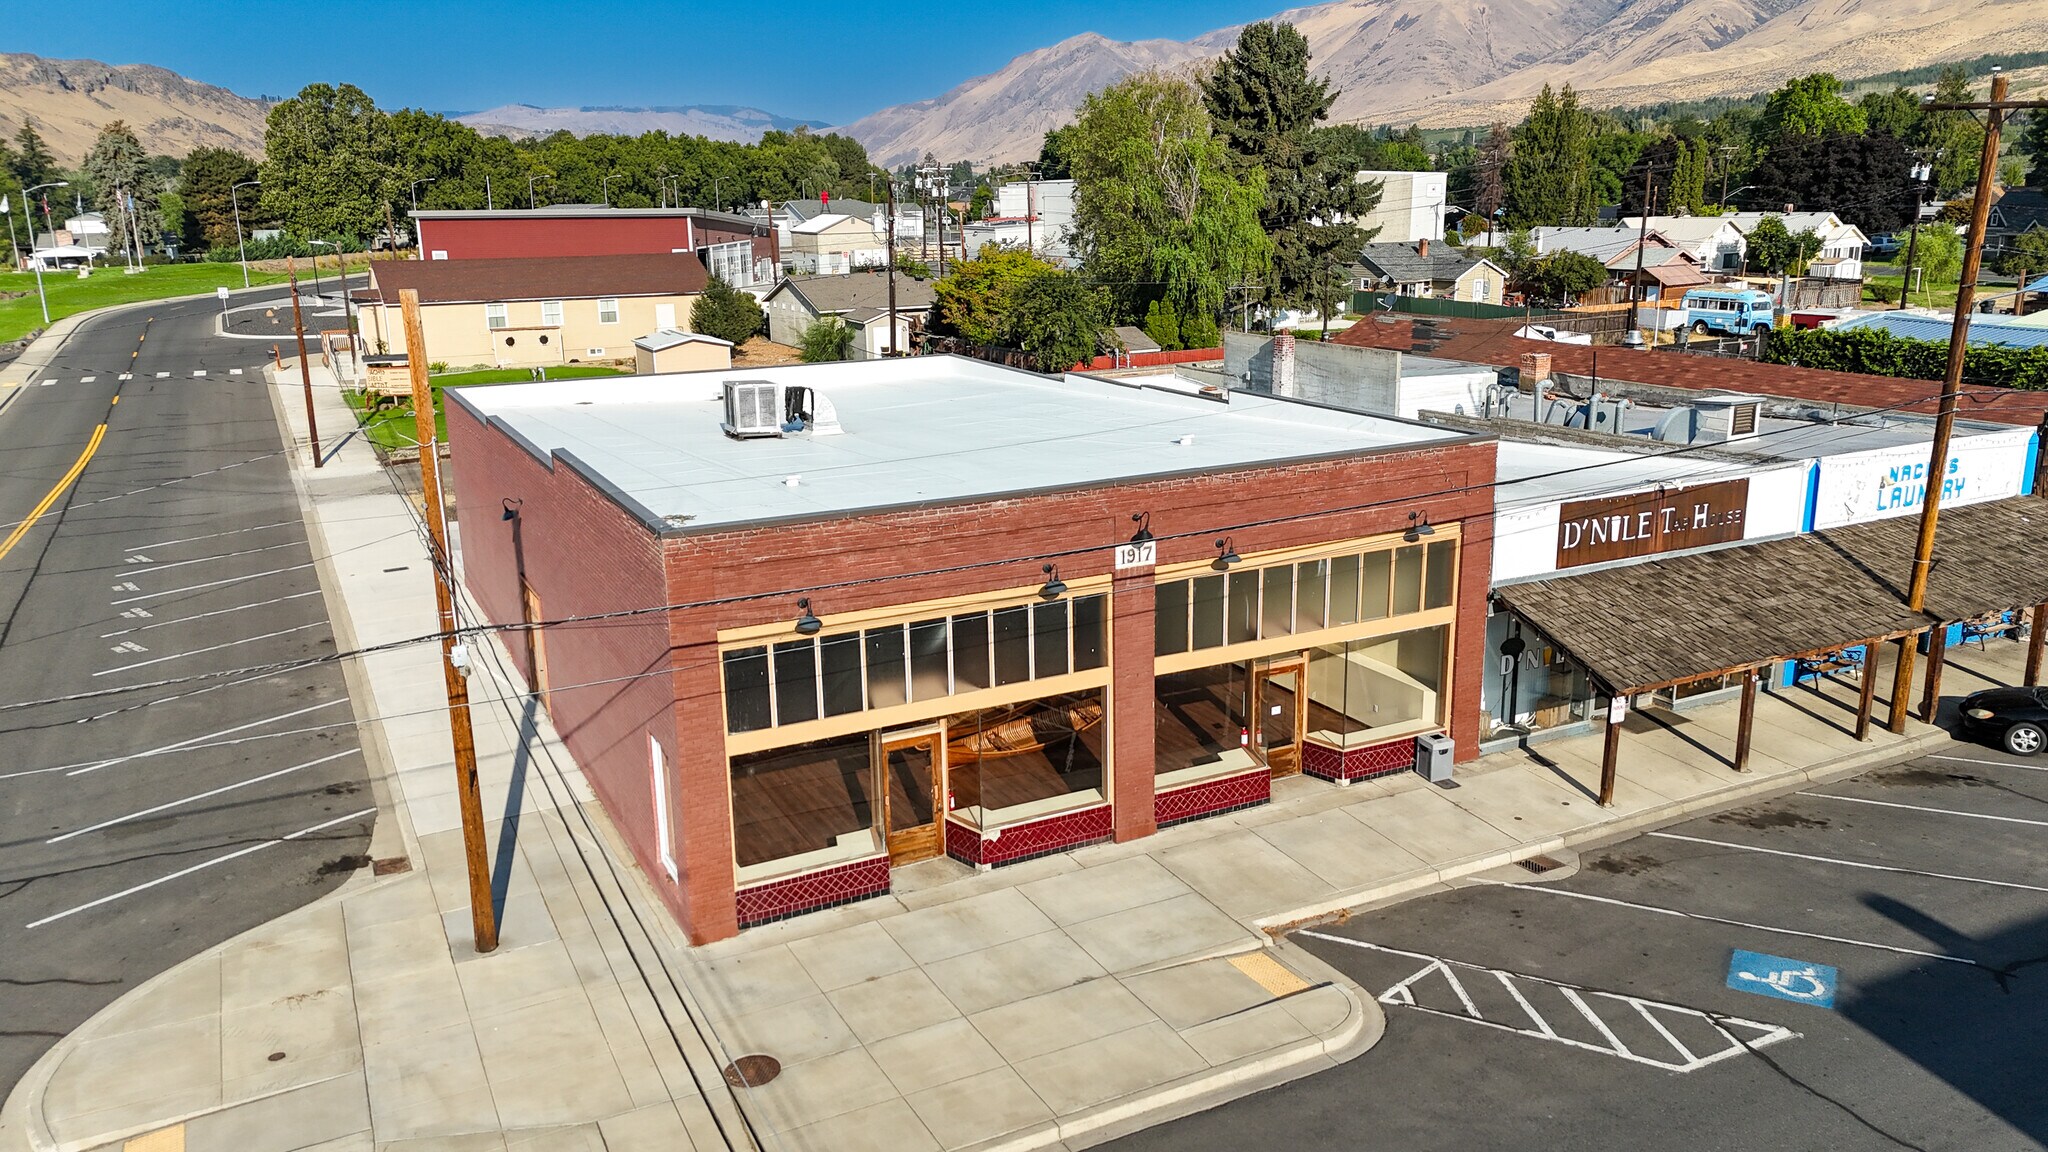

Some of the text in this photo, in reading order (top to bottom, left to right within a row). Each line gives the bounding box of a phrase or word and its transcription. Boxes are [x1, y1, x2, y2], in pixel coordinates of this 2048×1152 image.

[1889, 457, 1960, 483] NACS
[1876, 477, 1966, 511] LAUNRY
[1121, 545, 1153, 565] 1917
